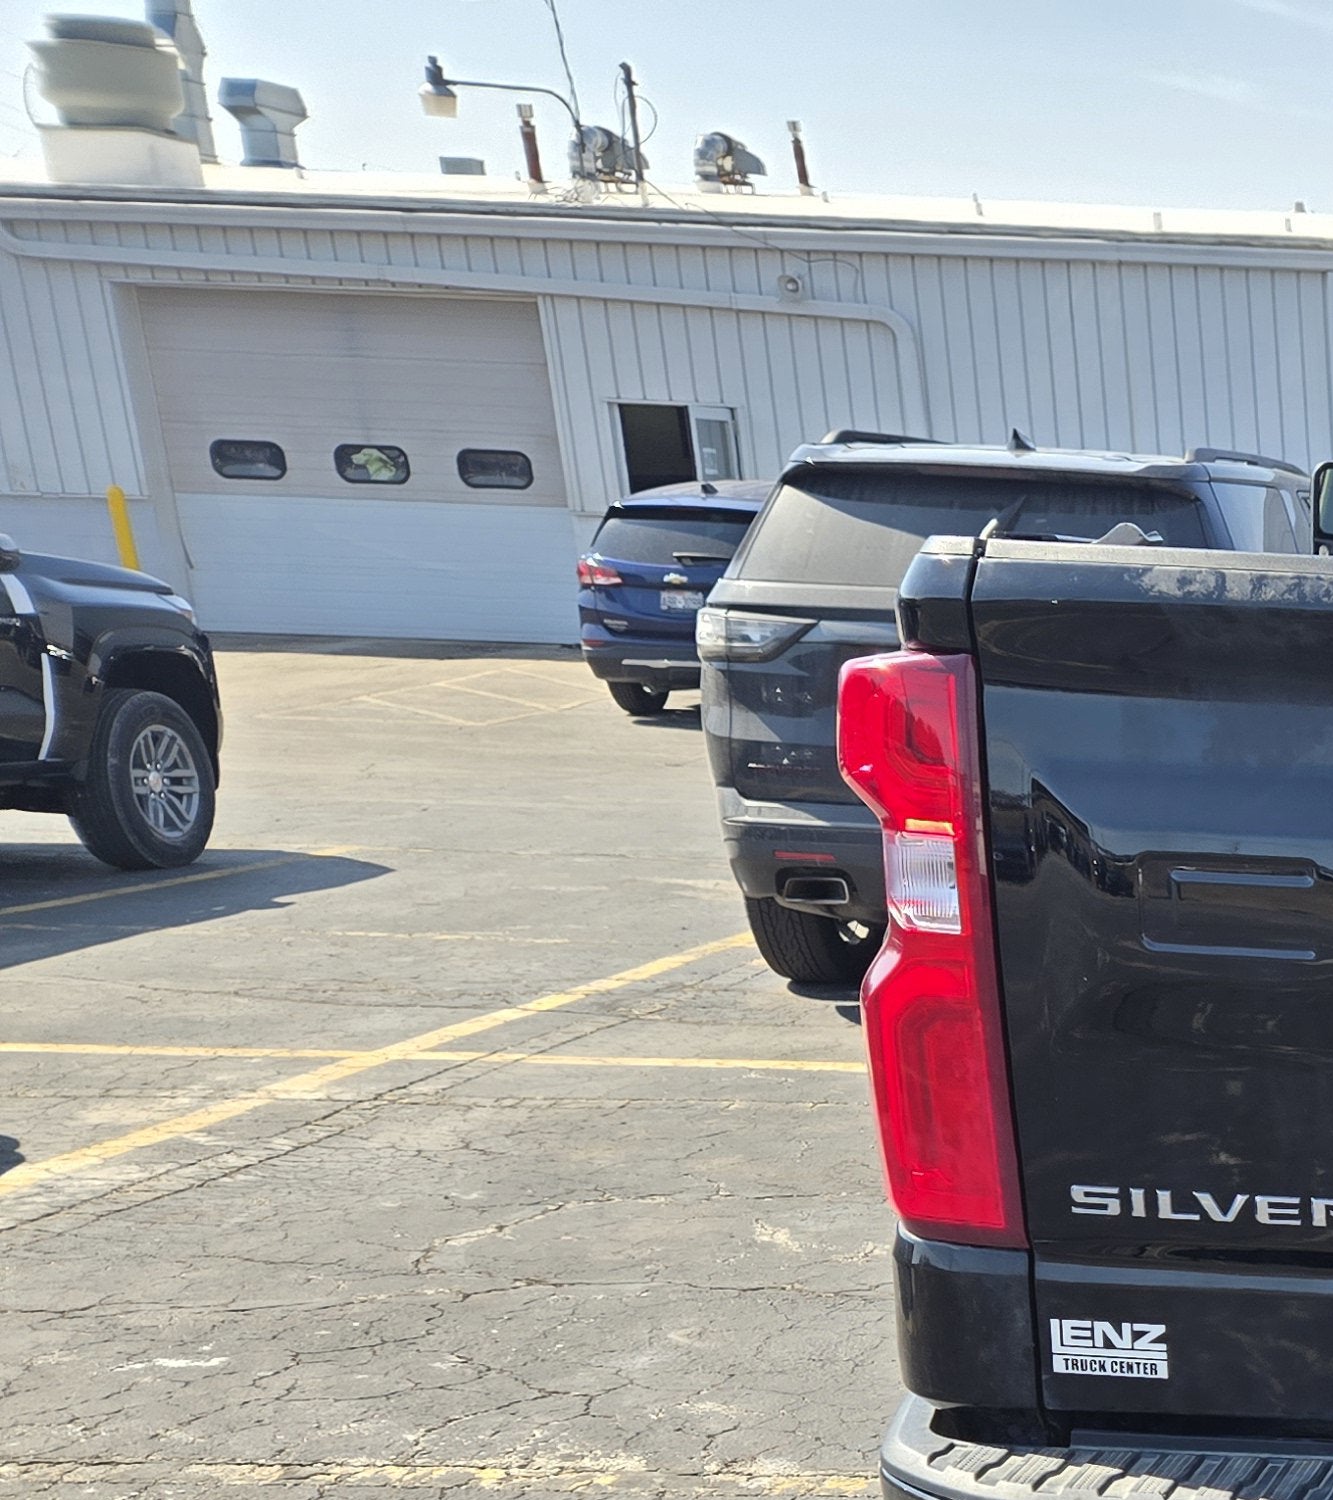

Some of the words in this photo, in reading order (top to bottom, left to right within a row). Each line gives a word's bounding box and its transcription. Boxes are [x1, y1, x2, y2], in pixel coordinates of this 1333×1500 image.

[1049, 1318, 1168, 1360] LENZ
[1062, 1357, 1107, 1373] TRUCK
[1110, 1360, 1158, 1376] CENTER
